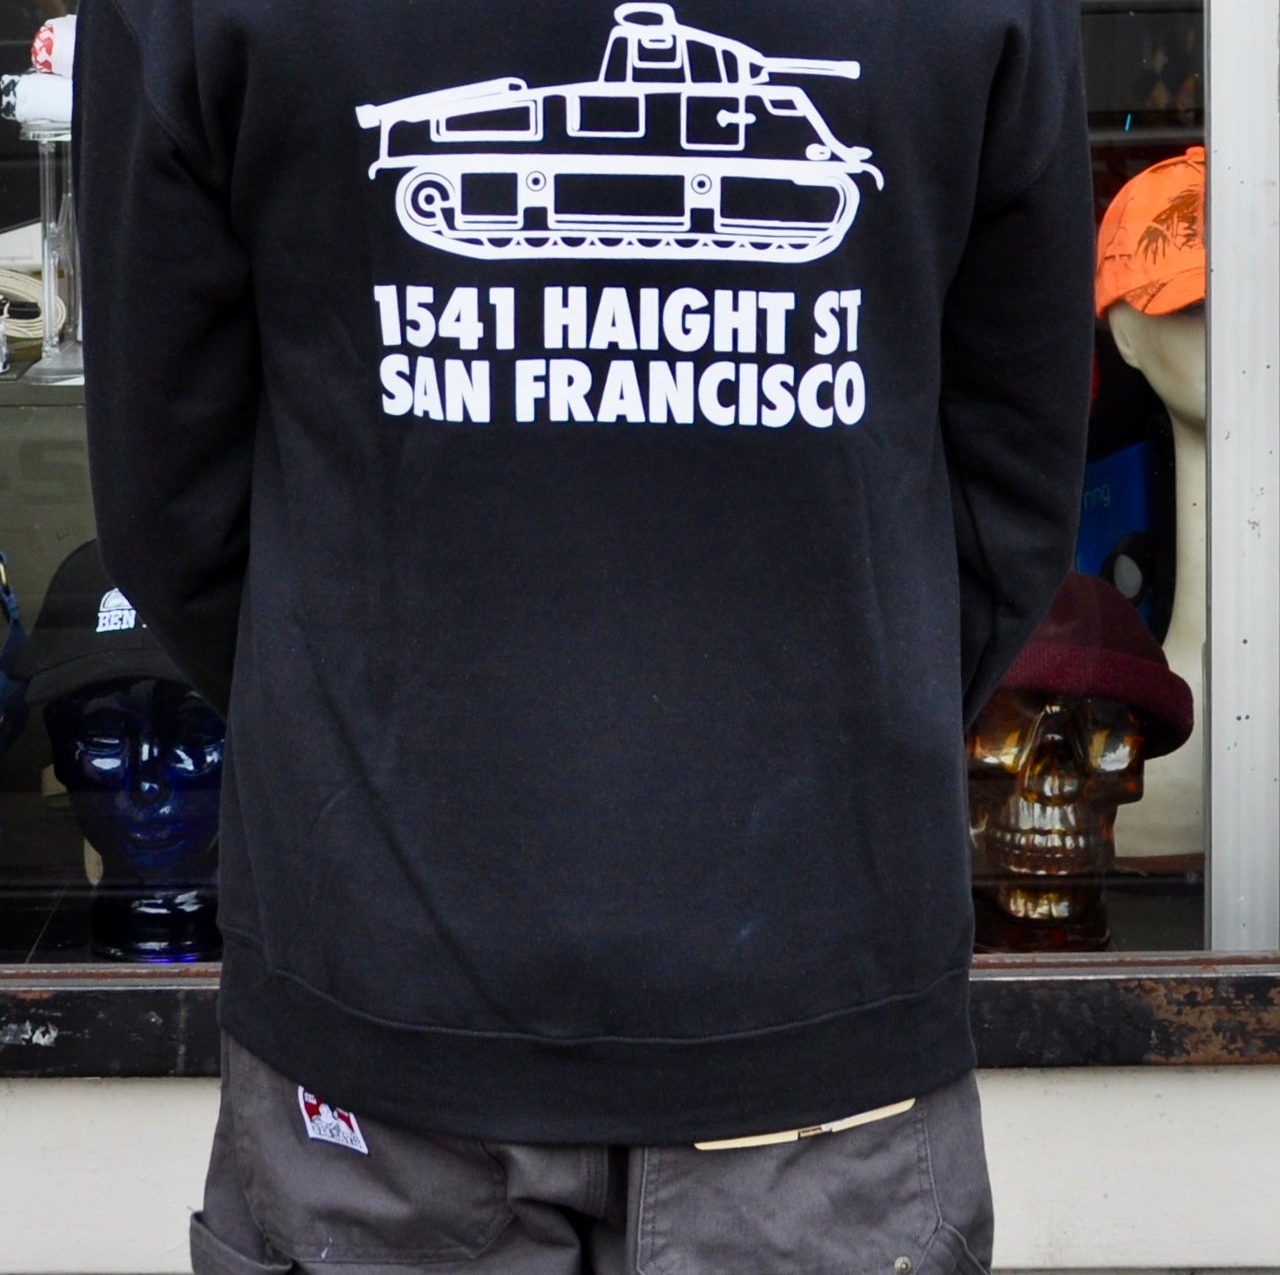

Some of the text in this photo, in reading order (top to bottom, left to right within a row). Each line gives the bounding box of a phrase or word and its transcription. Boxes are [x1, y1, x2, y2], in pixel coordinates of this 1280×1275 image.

[373, 285, 862, 355] 1541 HAIGHT ST
[379, 353, 866, 427] SAN FRANCISCO
[96, 609, 136, 633] BEN
